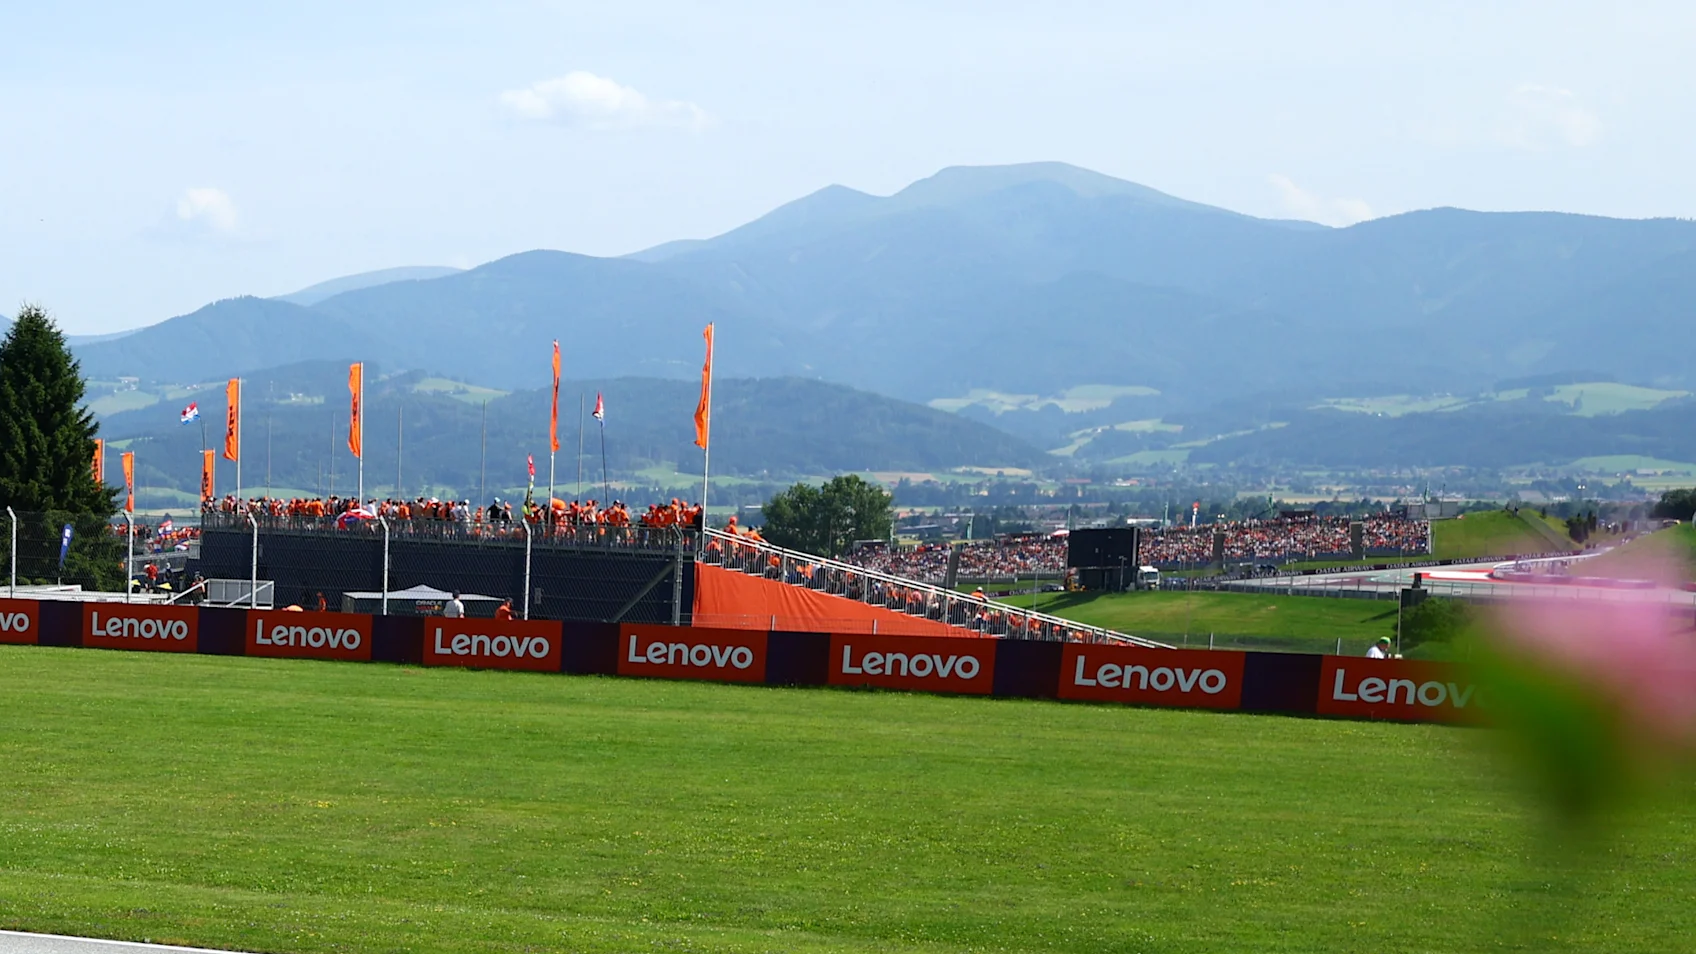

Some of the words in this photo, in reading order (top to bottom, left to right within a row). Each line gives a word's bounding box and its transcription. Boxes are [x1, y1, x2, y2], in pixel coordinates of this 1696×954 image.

[91, 611, 189, 641] Lenovo
[256, 619, 361, 650] Lenovo
[434, 628, 549, 659] Lenovo
[628, 635, 753, 670] Lenovo
[841, 645, 980, 680] Lenovo
[1074, 655, 1227, 694] Lenovo
[1332, 668, 1492, 708] Lenov
